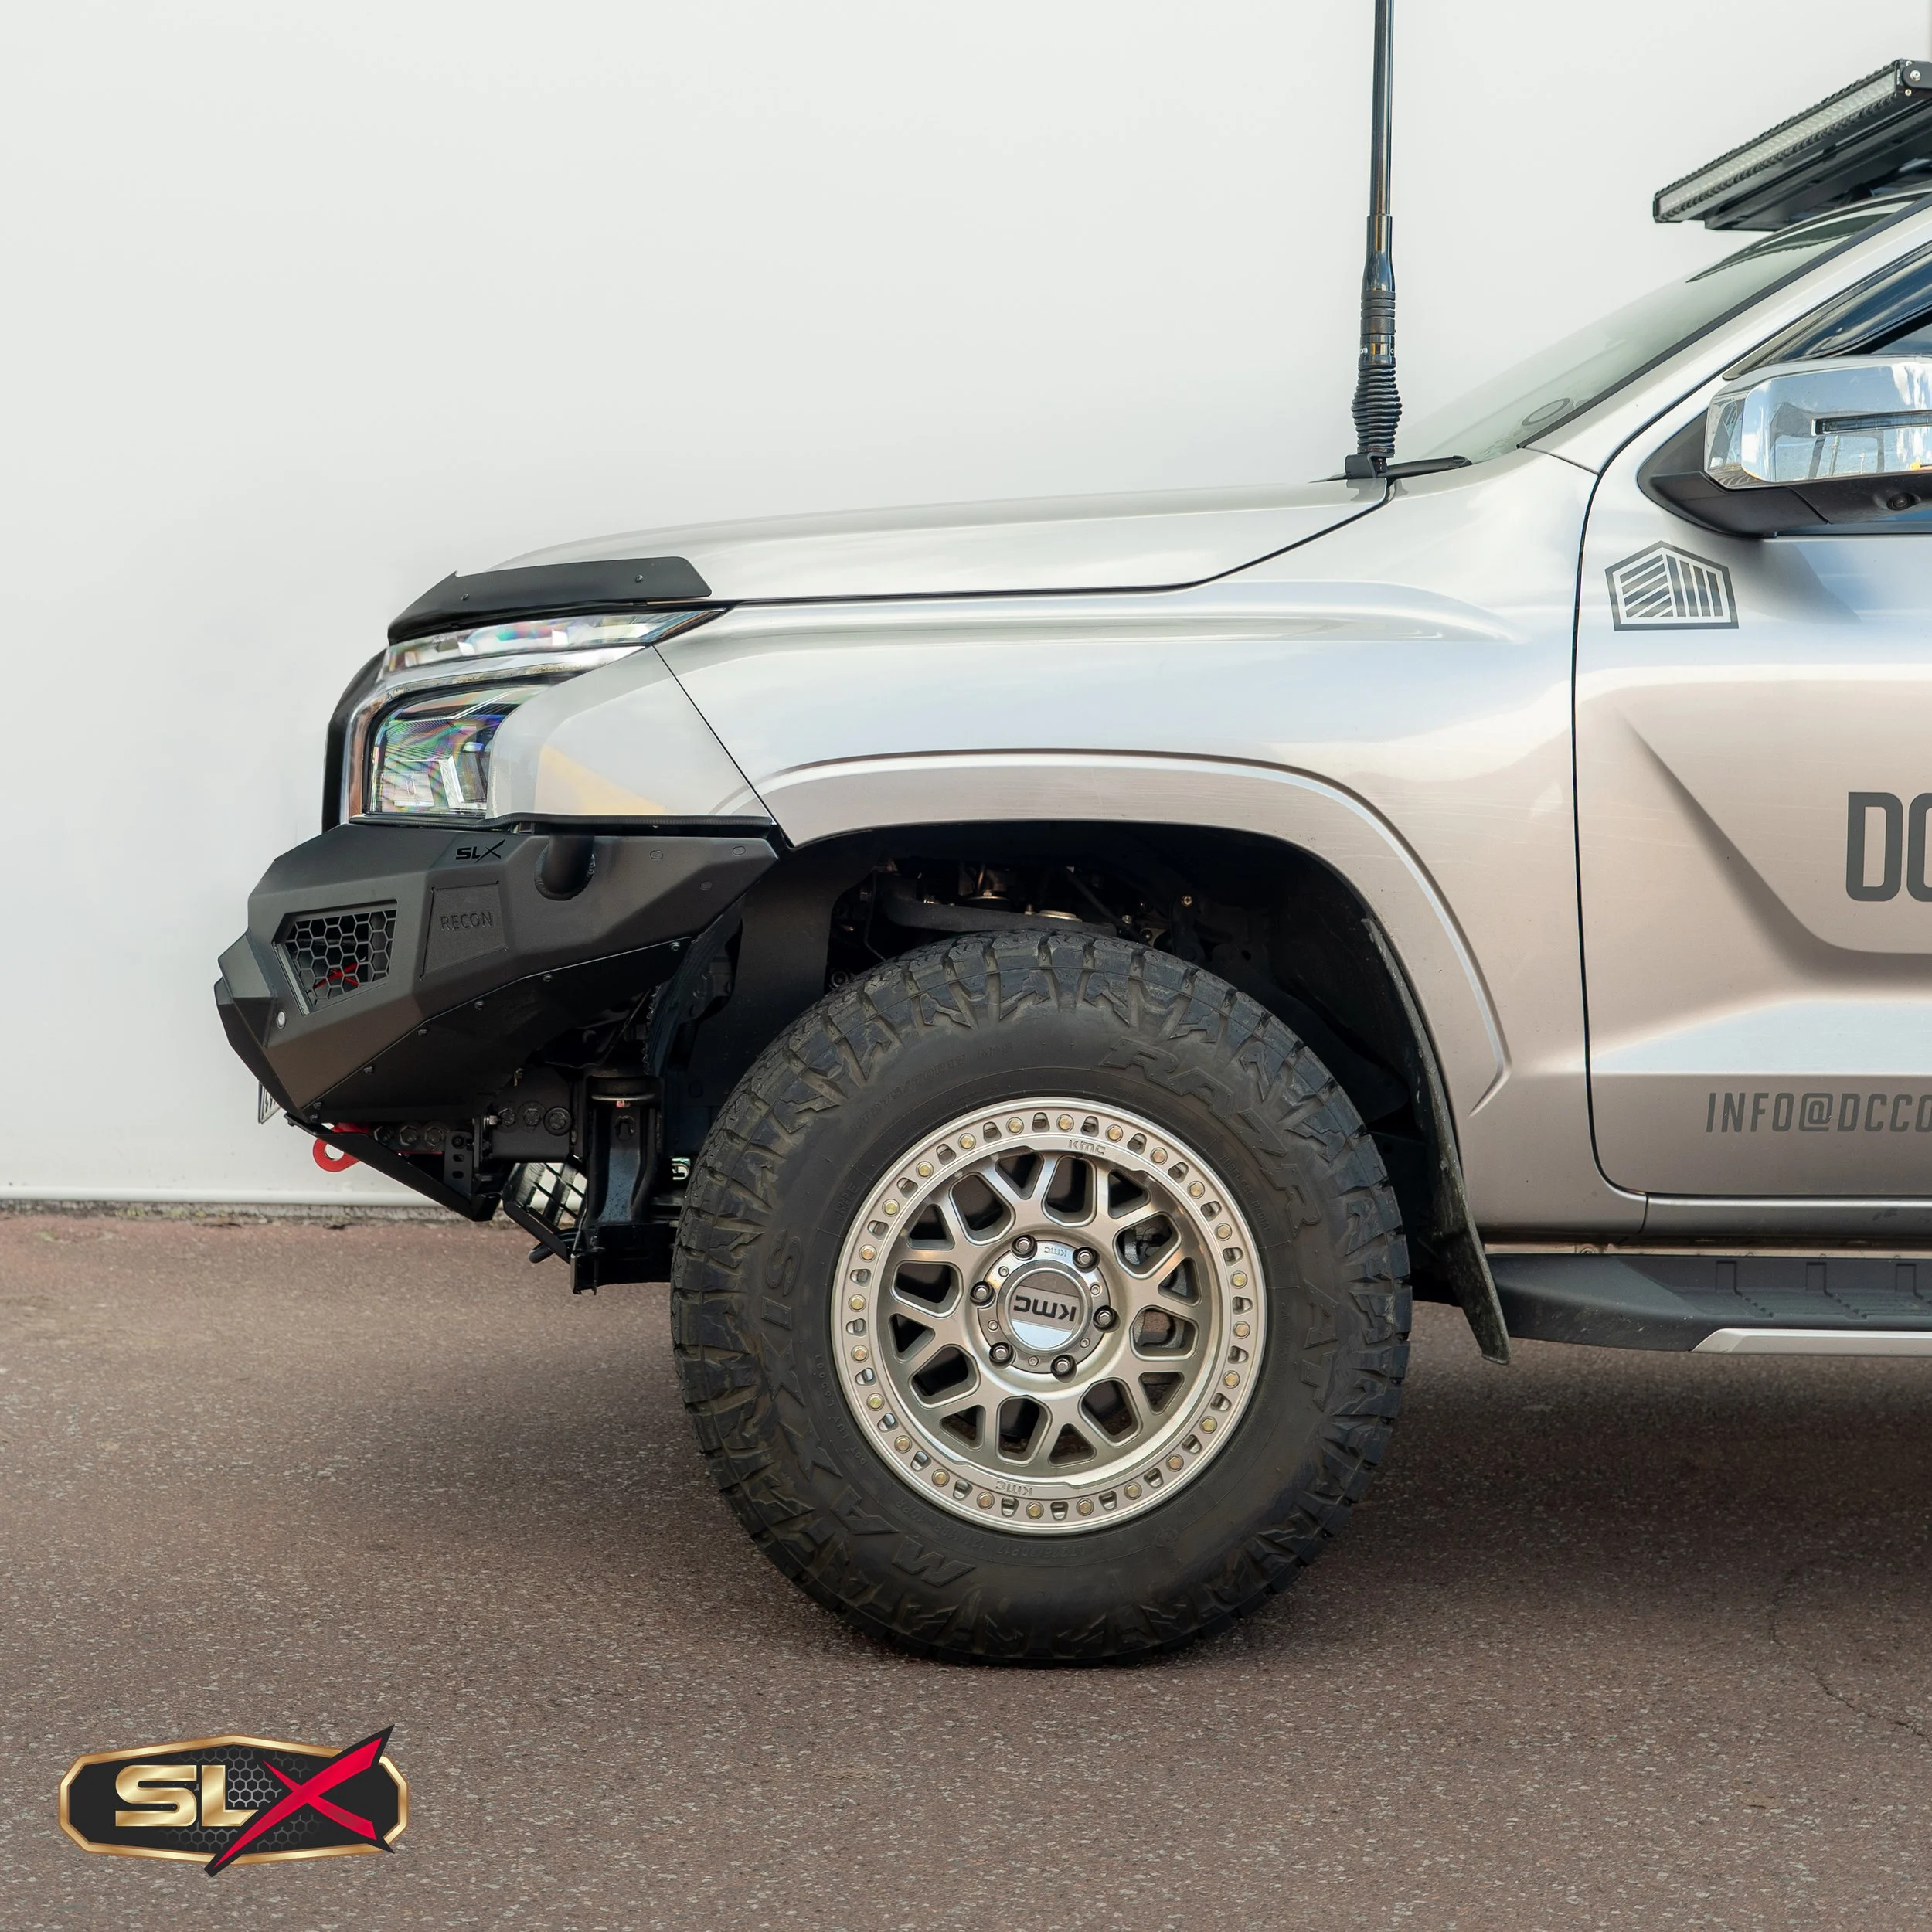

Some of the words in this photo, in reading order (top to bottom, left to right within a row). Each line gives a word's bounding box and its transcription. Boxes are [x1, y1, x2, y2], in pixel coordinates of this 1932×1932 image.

[455, 839, 505, 863] SLX
[440, 911, 494, 931] RECON
[1706, 1092, 1932, 1134] INFO@DCCO
